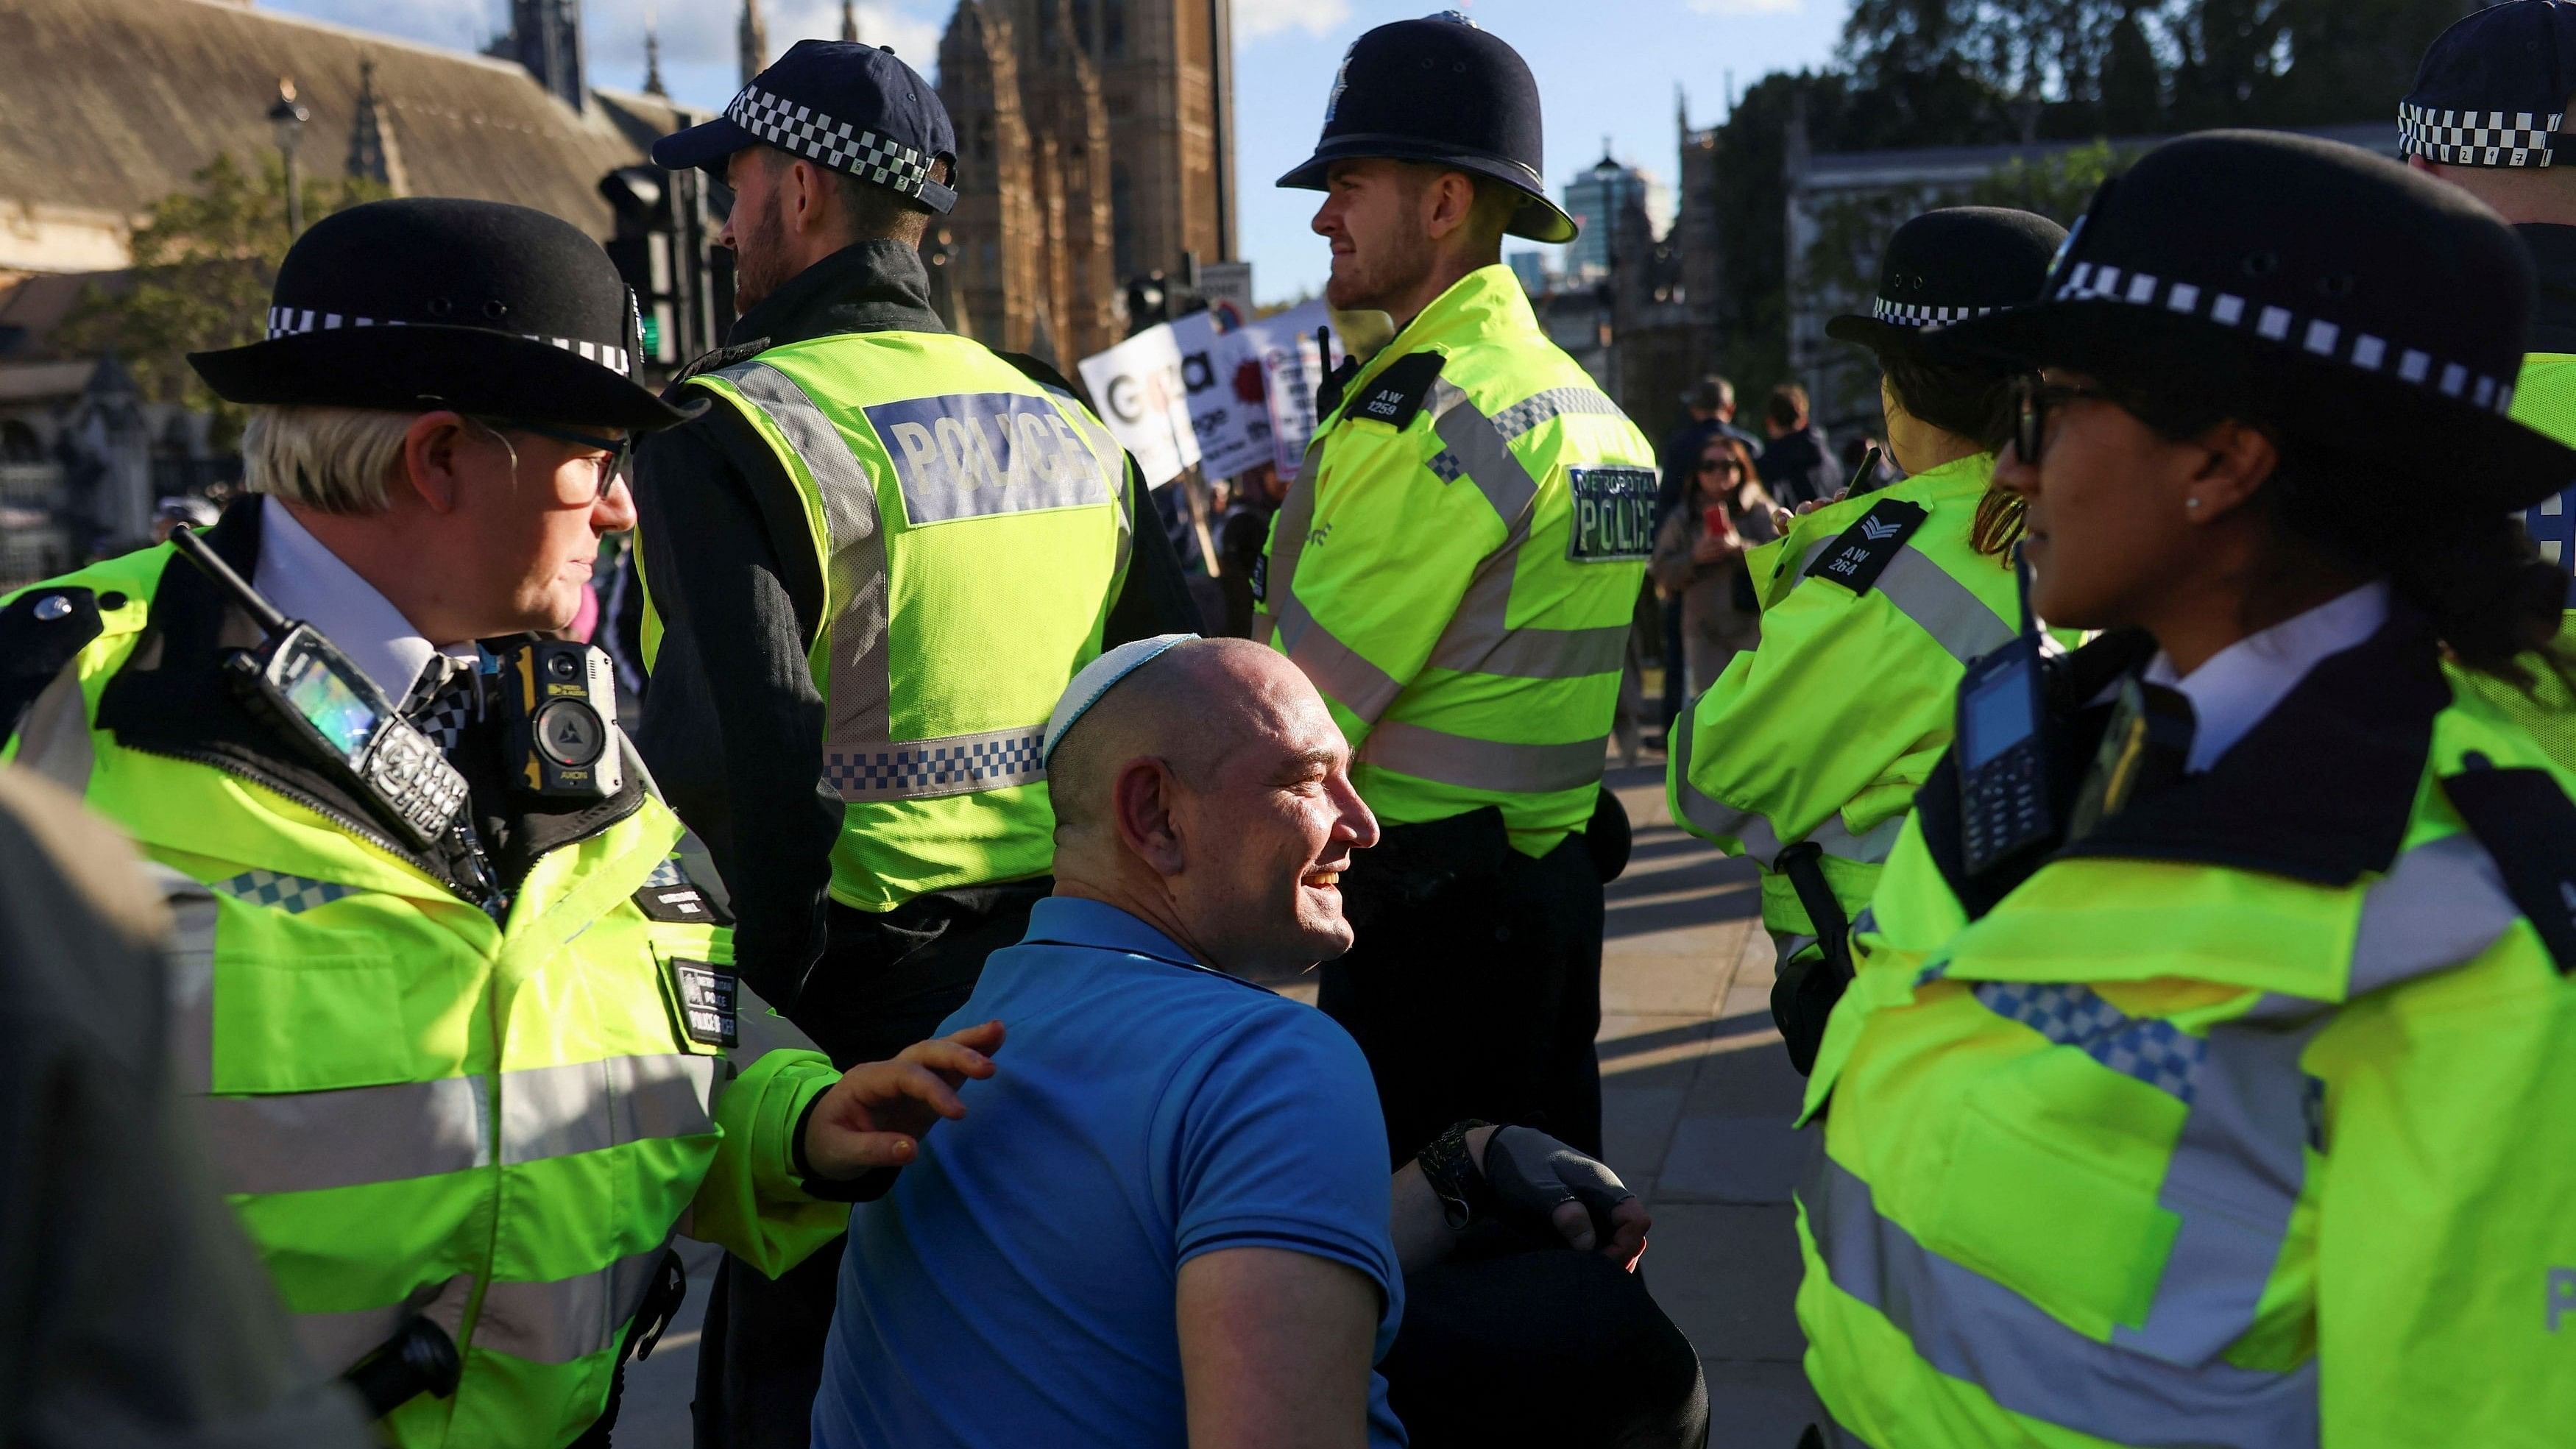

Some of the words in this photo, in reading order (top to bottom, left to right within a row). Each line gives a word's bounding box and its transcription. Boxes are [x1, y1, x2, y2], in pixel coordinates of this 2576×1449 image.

[1376, 389, 1404, 403] AW
[1367, 400, 1397, 415] 1259
[890, 412, 1096, 496] POLICE
[1577, 473, 1656, 497] METROPOTAN
[1841, 546, 1870, 563] AW
[1828, 558, 1858, 575] 264
